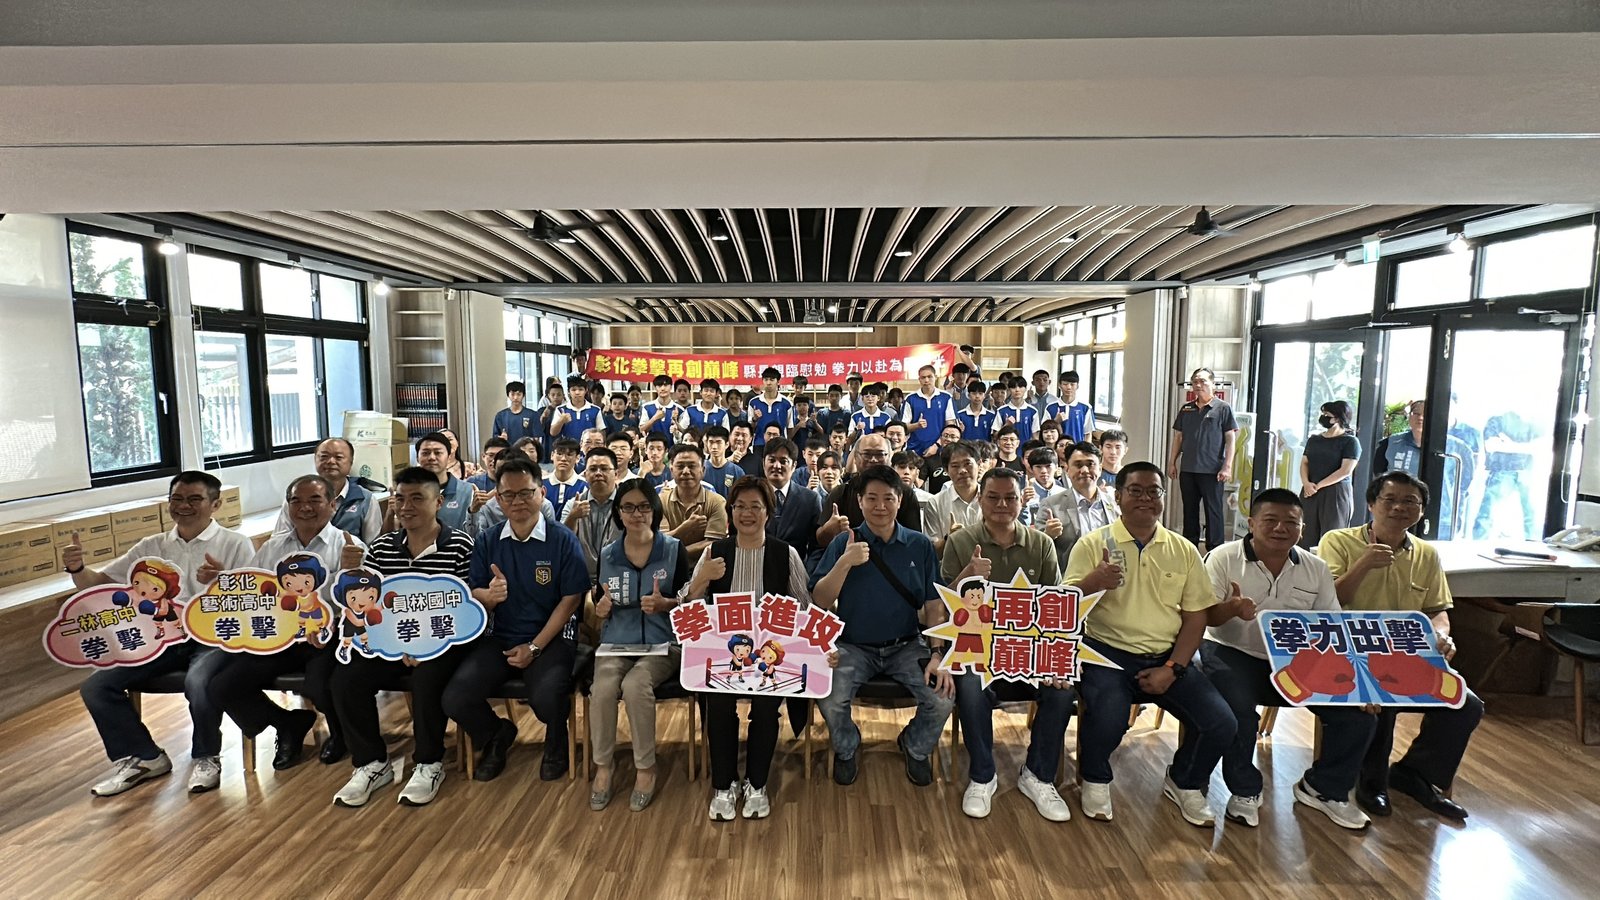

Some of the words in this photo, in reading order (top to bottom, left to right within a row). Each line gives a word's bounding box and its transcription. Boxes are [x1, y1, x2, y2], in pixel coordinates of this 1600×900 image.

[594, 355, 739, 380] 彰化拳擊再創巔峰
[218, 573, 257, 592] 彰化
[200, 593, 276, 613] 藝術高中
[391, 590, 462, 614] 員林國中
[994, 588, 1078, 632] 再創
[59, 606, 137, 636] 二林高中
[215, 616, 277, 640] 拳擊
[397, 615, 455, 642] 拳擊
[671, 593, 844, 653] 拳面進攻
[81, 627, 146, 659] 拳擊
[1270, 618, 1431, 655] 拳力出擊
[992, 636, 1076, 677] 巔峰
